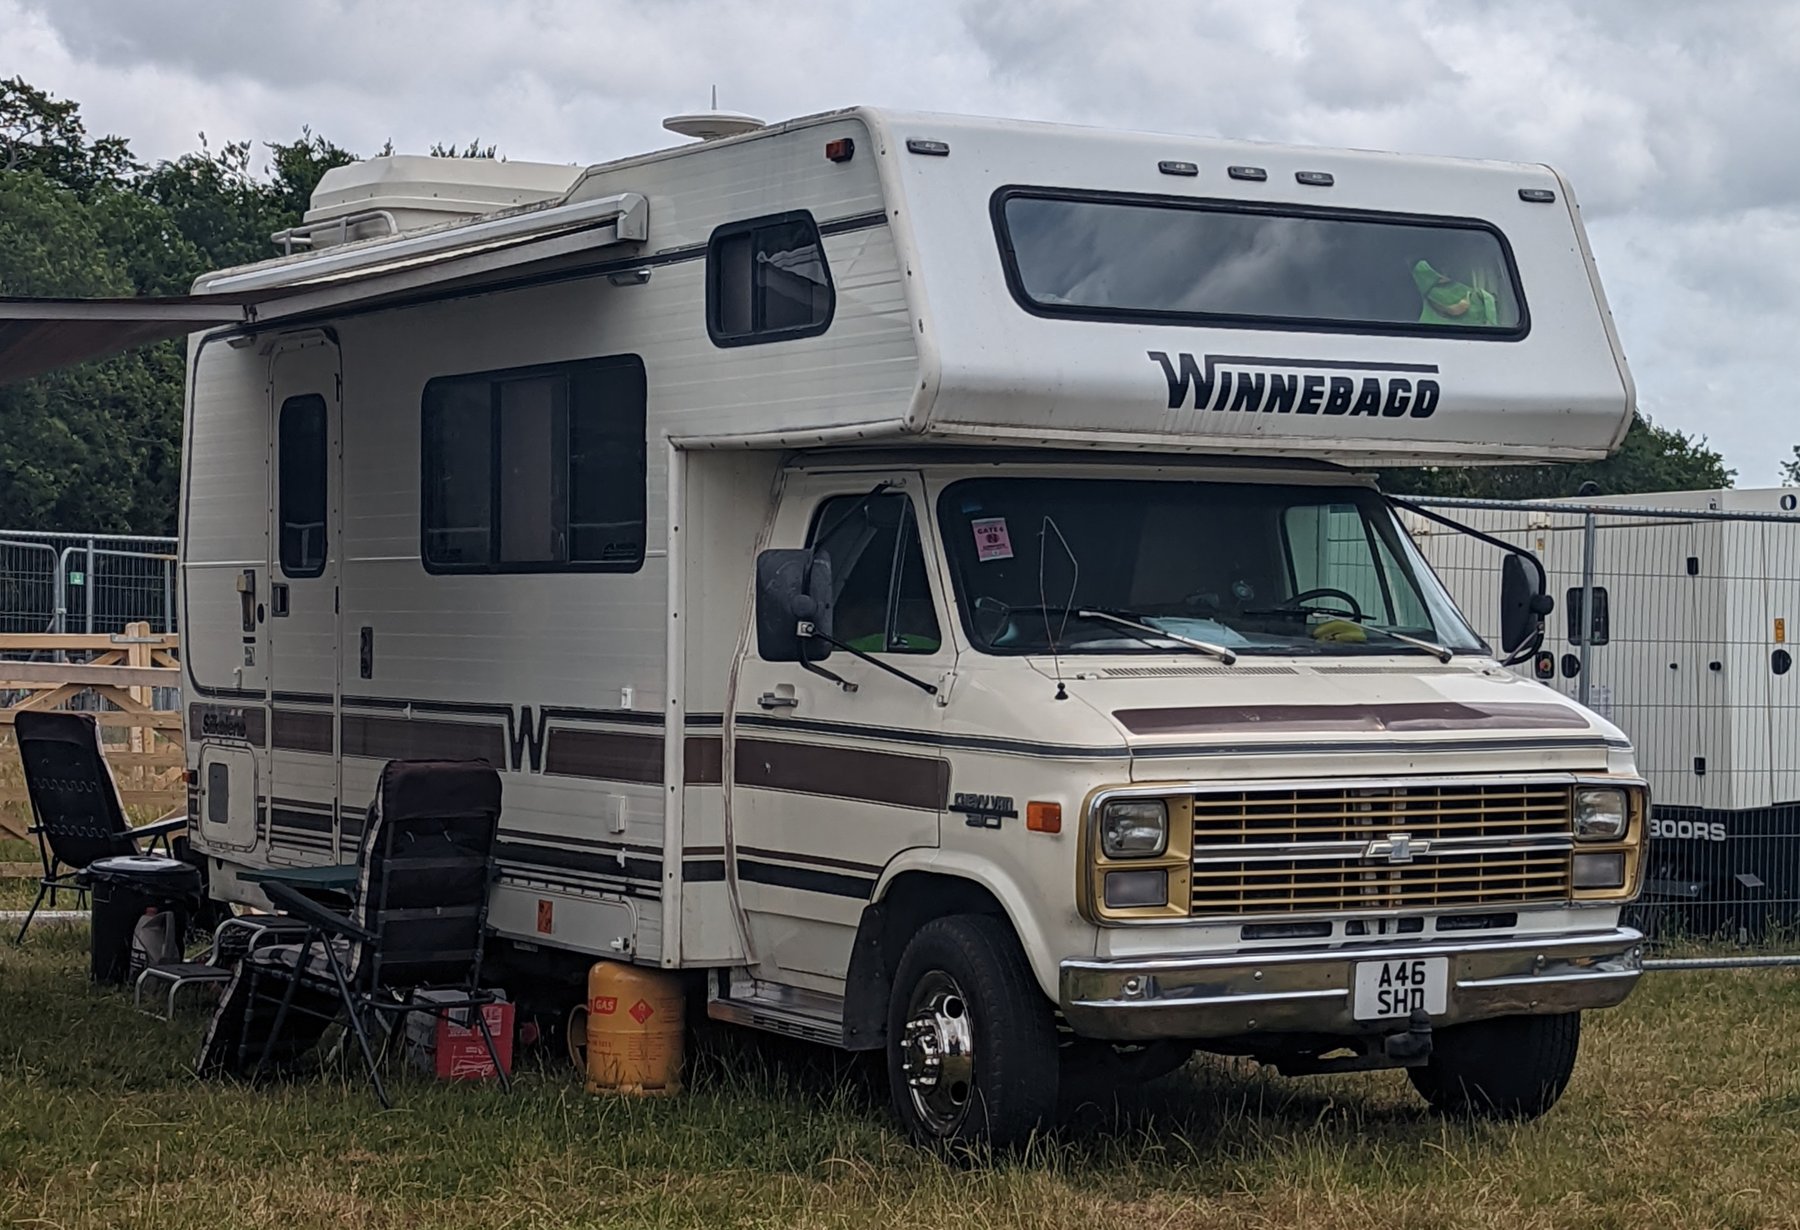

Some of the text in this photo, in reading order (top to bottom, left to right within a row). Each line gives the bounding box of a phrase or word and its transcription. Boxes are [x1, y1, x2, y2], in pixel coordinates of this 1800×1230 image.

[1147, 351, 1439, 418] WINNEBAGO
[1378, 961, 1425, 988] A46
[595, 1000, 614, 1011] GAS
[1377, 988, 1425, 1015] SHD
